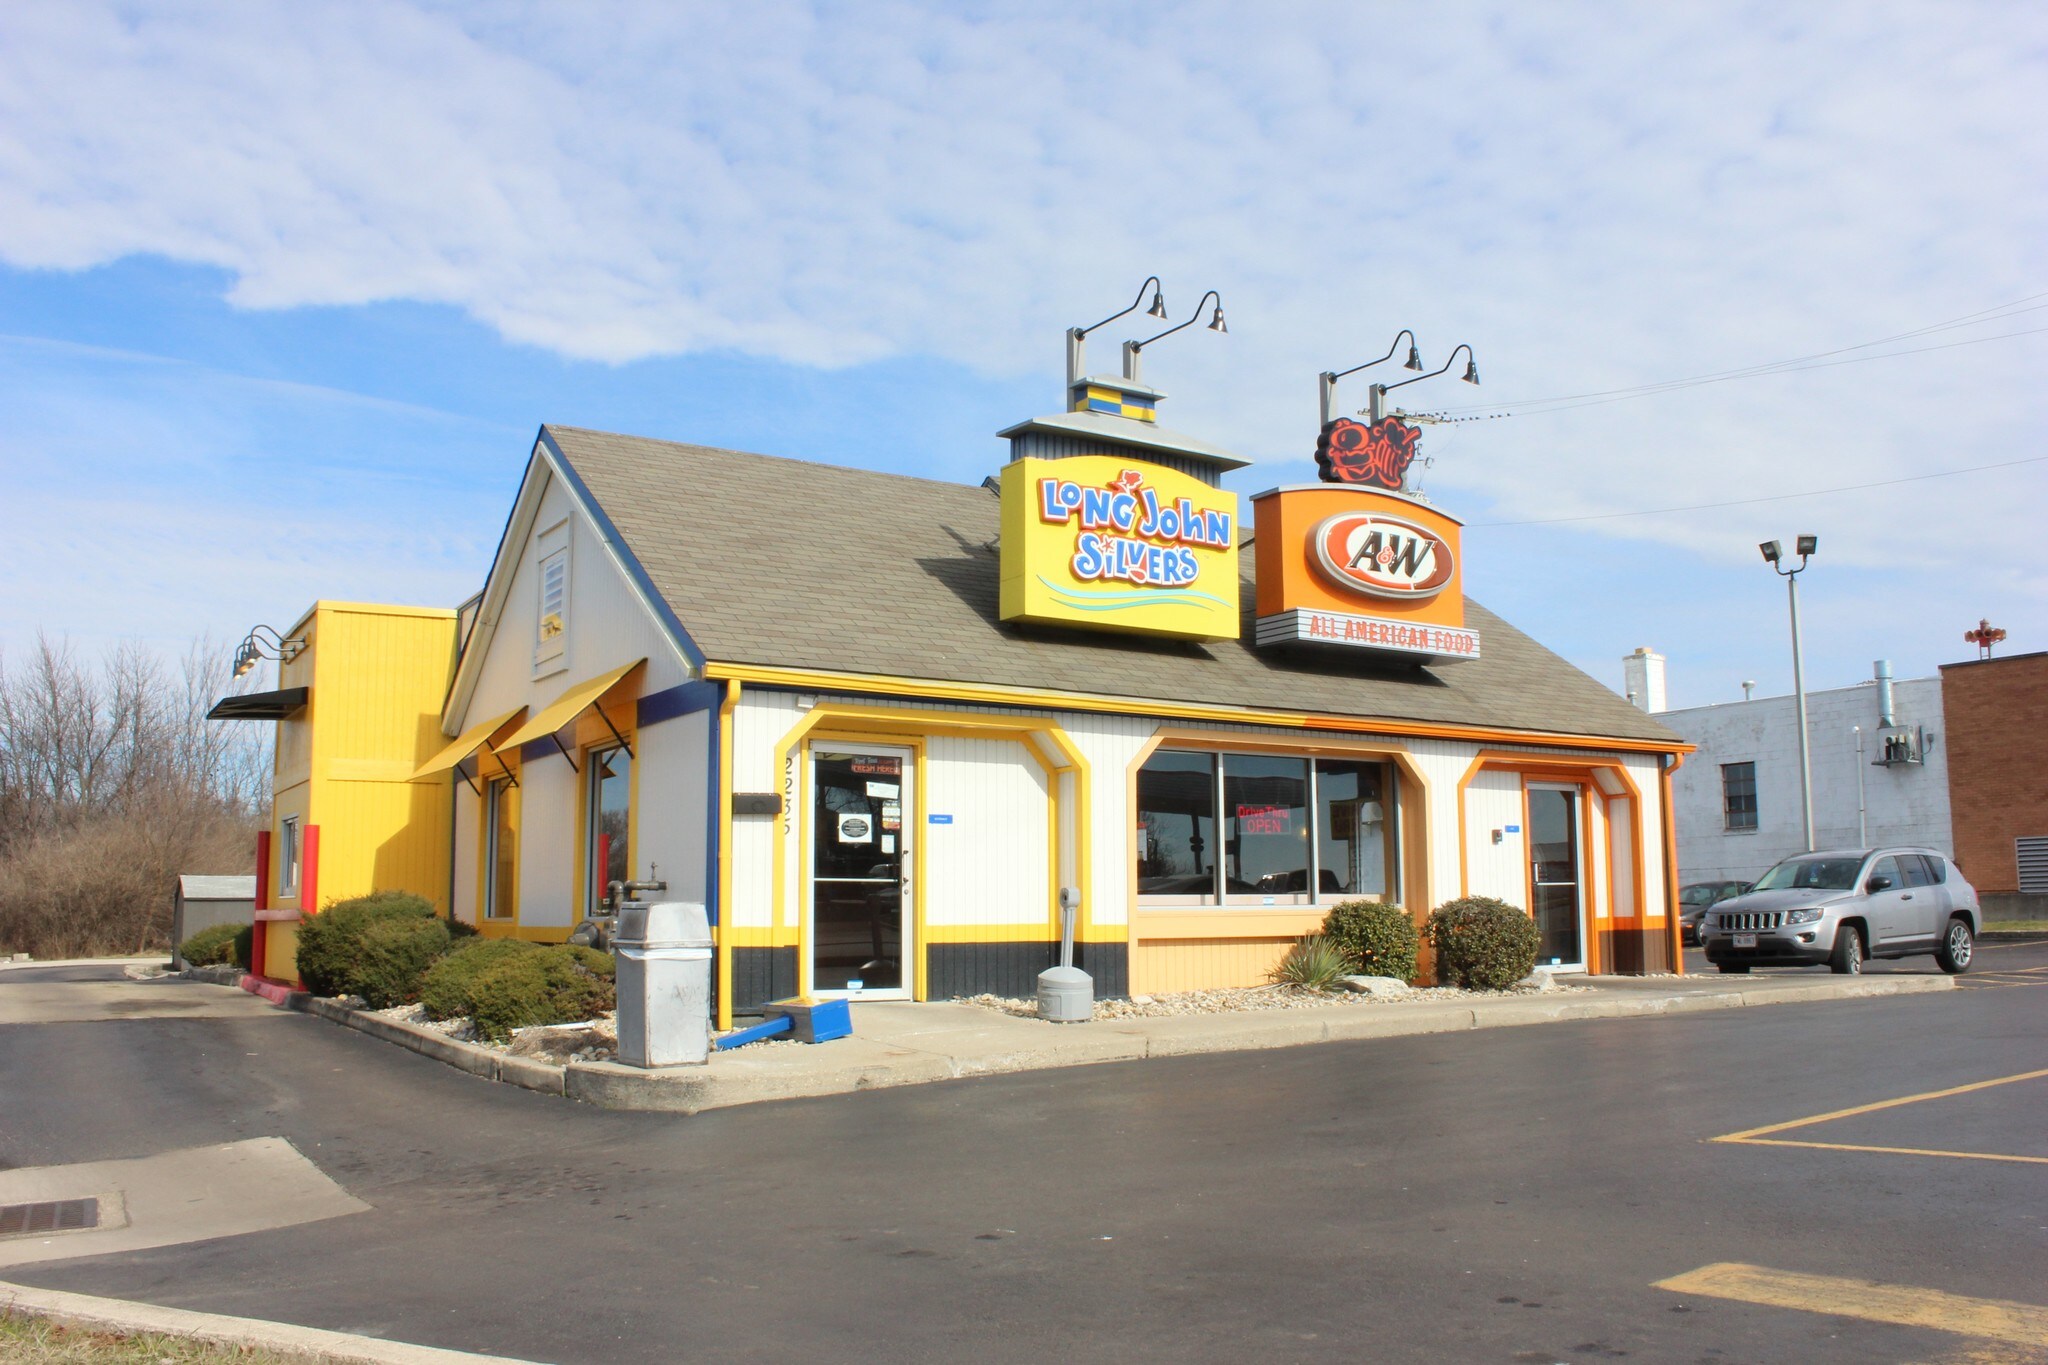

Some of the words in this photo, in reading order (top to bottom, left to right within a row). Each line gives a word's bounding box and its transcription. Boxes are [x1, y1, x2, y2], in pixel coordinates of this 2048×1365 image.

[1345, 530, 1437, 578] A&W
[1310, 615, 1338, 639] ALL
[1344, 619, 1429, 649] AMERICAN
[1434, 631, 1474, 655] FOOD
[1238, 806, 1265, 818] Drive
[1265, 806, 1289, 818] Thru
[1247, 819, 1281, 833] OPEN
